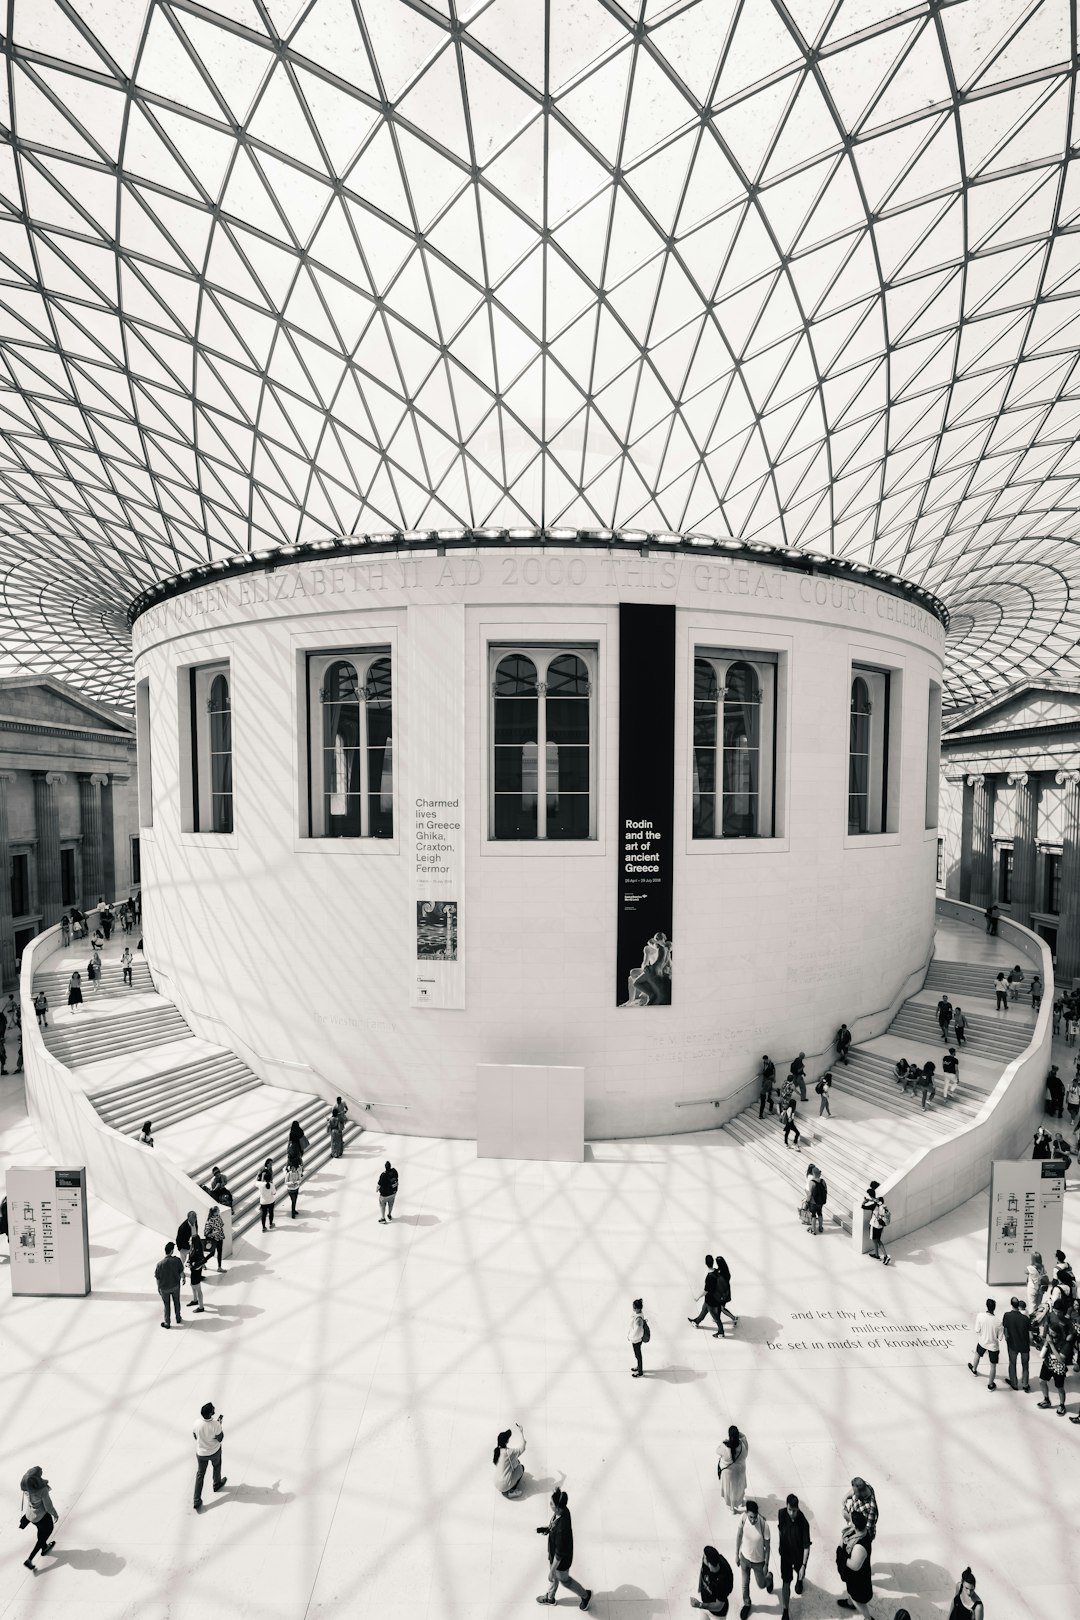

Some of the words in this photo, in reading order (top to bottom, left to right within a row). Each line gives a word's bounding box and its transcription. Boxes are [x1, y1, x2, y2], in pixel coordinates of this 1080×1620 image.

[174, 584, 230, 623] QUEEN
[238, 564, 388, 606] ELIZABETH
[401, 560, 423, 588] II
[435, 558, 484, 587] AD
[501, 557, 587, 586] 2000
[600, 558, 677, 589] THIS
[691, 564, 788, 600] GREAT
[799, 577, 870, 615] COURT
[415, 798, 459, 808] Charmed
[415, 809, 437, 819] lives
[415, 820, 424, 829] in
[426, 820, 461, 830] Greece
[625, 819, 653, 829] Rodin
[415, 831, 446, 841] Ghika,
[625, 830, 643, 840] and
[645, 830, 661, 840] the
[415, 842, 455, 853] Craxton,
[624, 841, 639, 851] art
[640, 841, 651, 851] of
[416, 853, 442, 864] Leigh
[624, 852, 660, 862] ancient
[416, 864, 450, 874] Fermor
[625, 863, 660, 873] Greece
[791, 1310, 814, 1320] and
[817, 1310, 833, 1319] let
[836, 1310, 857, 1321] thy
[861, 1309, 887, 1319] feet
[851, 1322, 928, 1333] millenniums
[930, 1322, 970, 1332] hence
[766, 1340, 783, 1350] be
[788, 1340, 808, 1350] set
[811, 1341, 824, 1350] in
[828, 1340, 863, 1350] midst
[867, 1338, 881, 1349] of
[886, 1337, 955, 1350] knowledge
